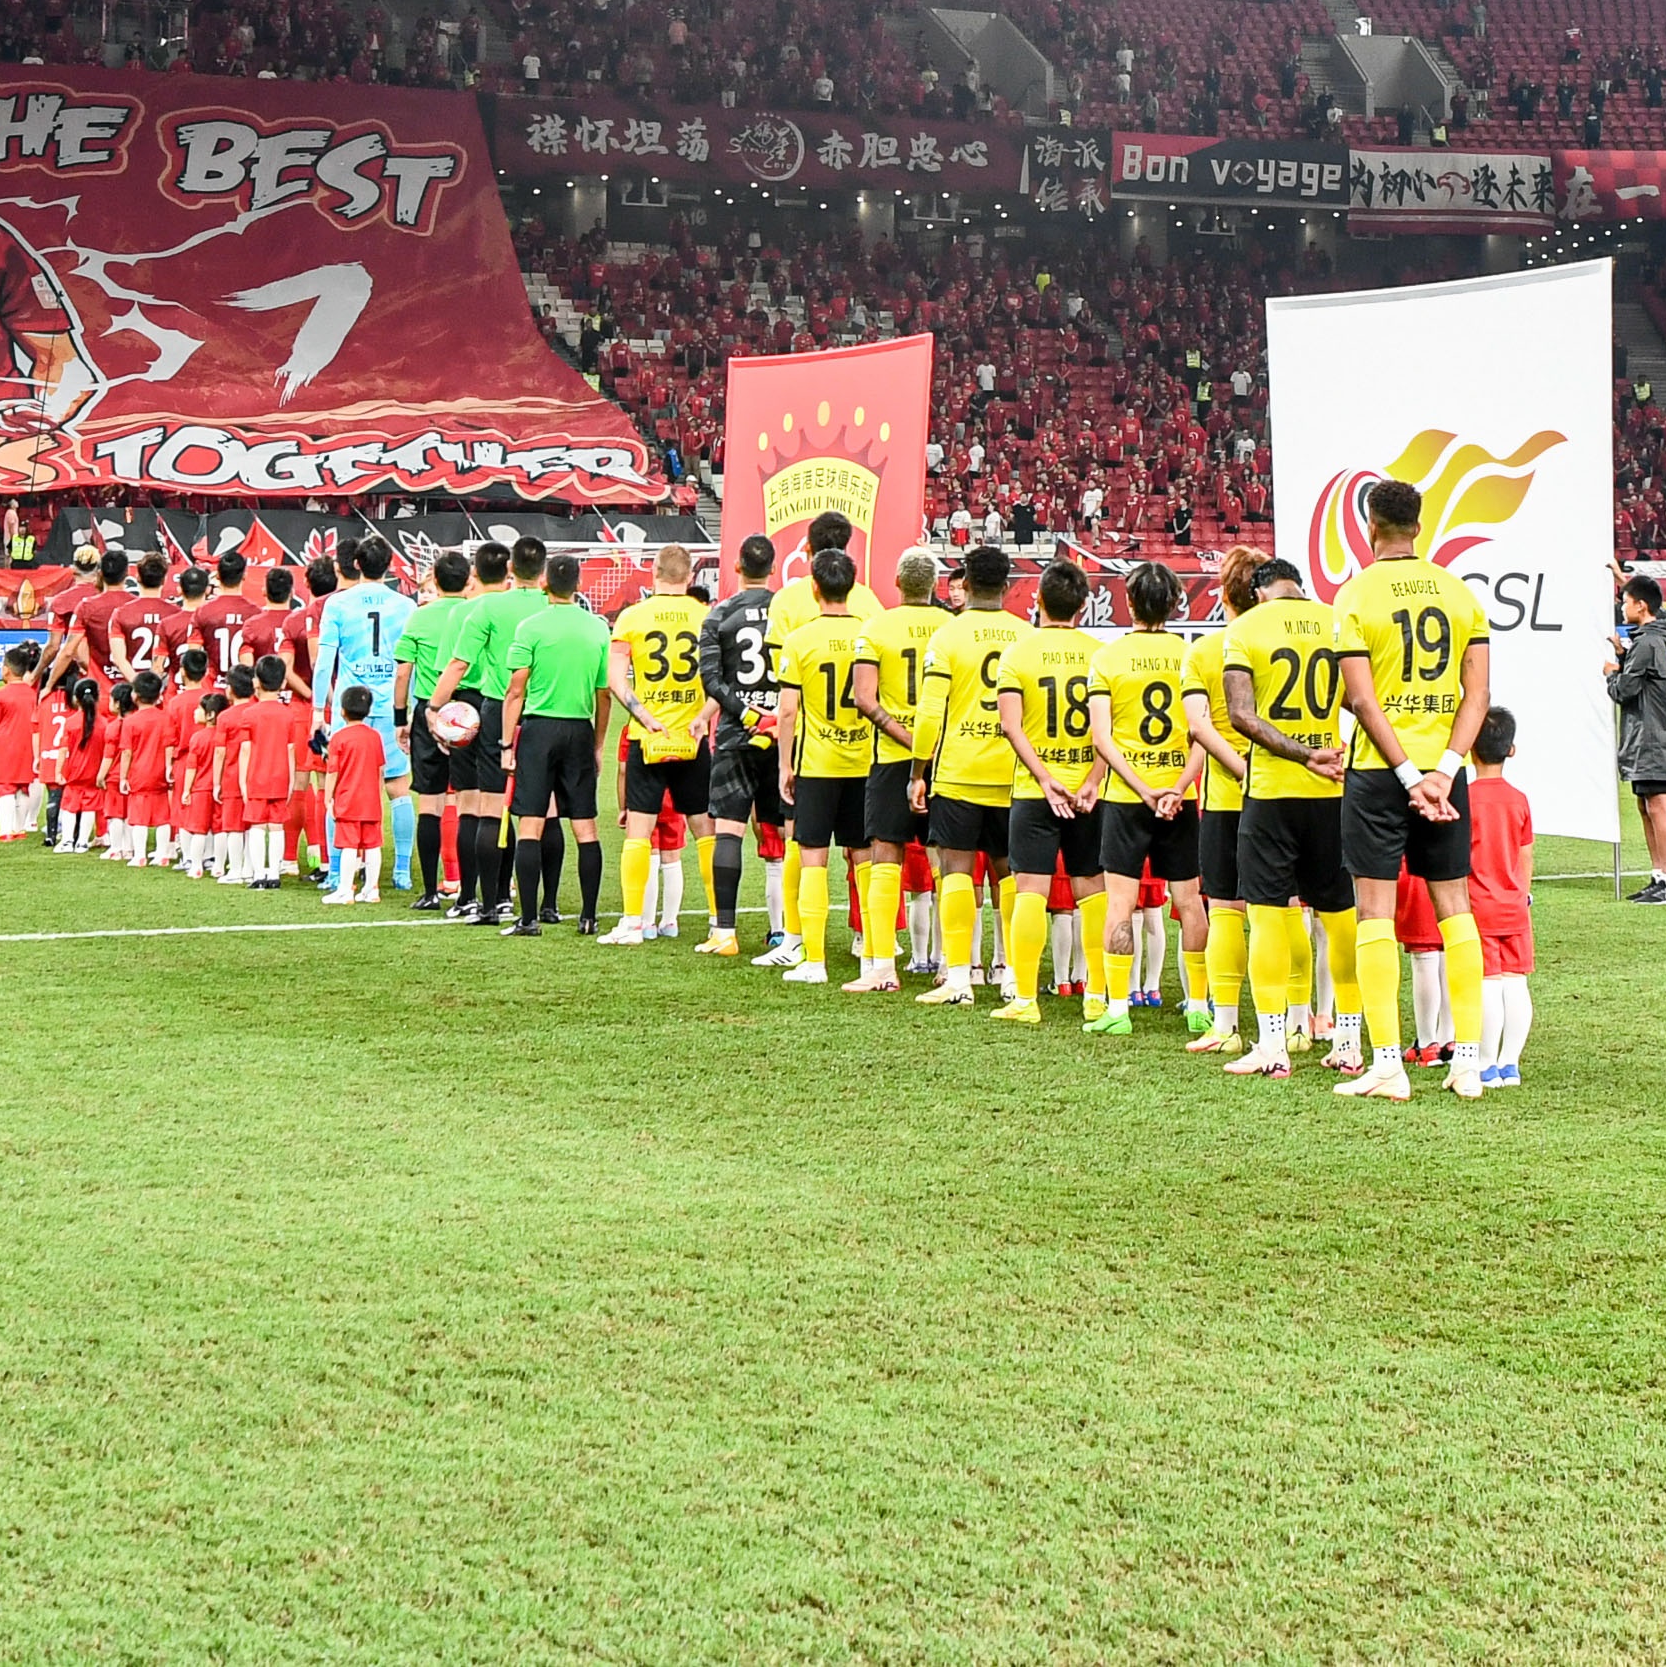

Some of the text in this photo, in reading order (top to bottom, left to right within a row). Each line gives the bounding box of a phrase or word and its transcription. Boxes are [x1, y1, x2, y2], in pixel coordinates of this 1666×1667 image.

[526, 113, 710, 163] 襟怀坦荡
[816, 129, 990, 173] 赤胆忠心
[1034, 134, 1107, 173] 海派
[176, 119, 456, 226] BEST
[1122, 143, 1189, 184] Bon
[826, 496, 853, 514] PORT
[368, 612, 380, 657] 1
[644, 630, 700, 682] 33
[974, 630, 1017, 642] B.RIASCOS
[1391, 606, 1451, 682] 19
[1043, 652, 1061, 665] PIAO
[1132, 658, 1161, 671] ZHANG
[643, 689, 696, 704] 兴华集团
[819, 662, 863, 721] 14
[980, 650, 1003, 712] 9
[1269, 647, 1337, 720] 20
[1038, 675, 1091, 738] 18
[1139, 681, 1172, 745] 8
[1383, 694, 1455, 713] 兴华集团
[1036, 746, 1093, 764] 兴华集团
[1124, 750, 1186, 767] 兴华集团
